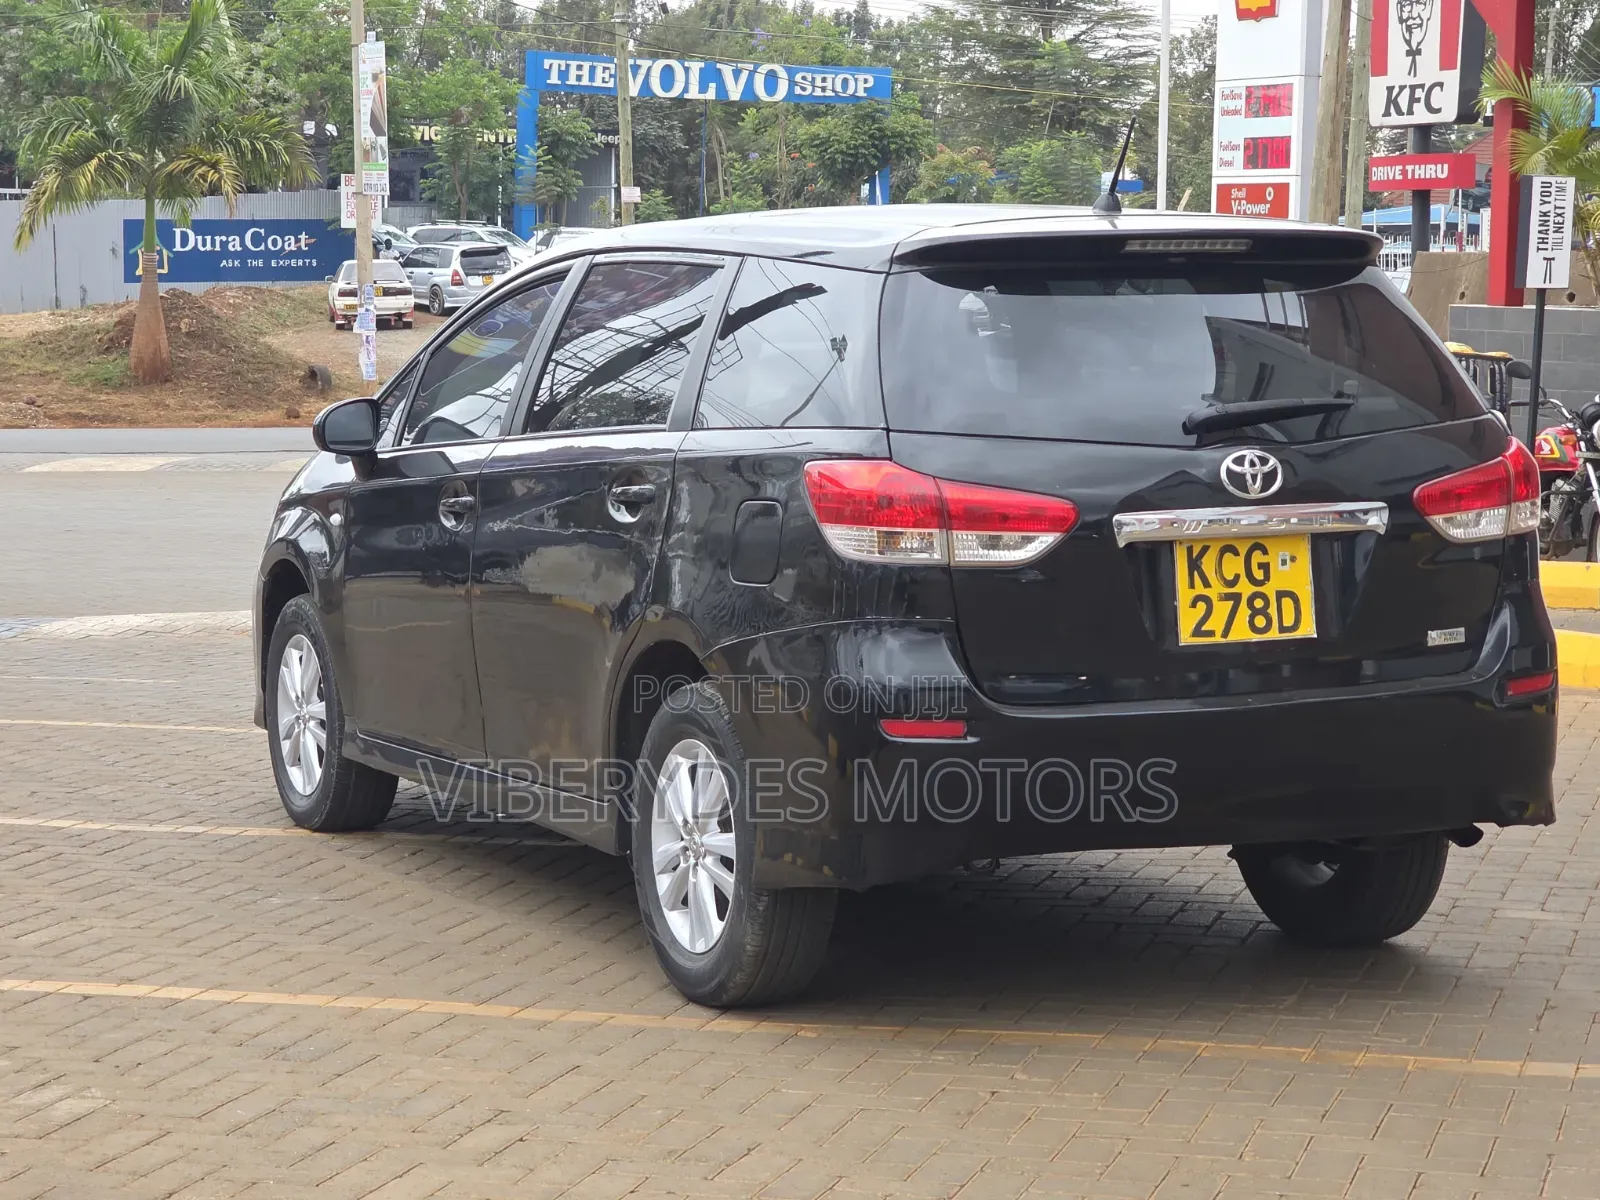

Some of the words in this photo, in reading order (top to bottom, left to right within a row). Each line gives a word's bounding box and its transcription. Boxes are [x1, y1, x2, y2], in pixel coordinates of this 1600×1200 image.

[543, 58, 615, 88] THE
[615, 58, 789, 102] VOLVO
[794, 71, 875, 97] SHOP
[1221, 90, 1242, 101] FuelSave
[1381, 81, 1445, 118] KFC
[1220, 105, 1242, 117] Unleaded
[1219, 141, 1241, 152] FuelSave
[1219, 157, 1235, 168] Diesel
[1371, 165, 1403, 181] DRIVE
[1405, 163, 1449, 180] THRU
[1231, 188, 1246, 199] Shell
[1539, 180, 1553, 209] YOU
[1555, 180, 1567, 204] TIME
[1231, 200, 1271, 215] V-Power
[1552, 204, 1566, 233] NEXT
[1536, 210, 1552, 253] THANK
[1551, 233, 1564, 252] TILL
[220, 259, 241, 267] ASK
[247, 259, 264, 267] THE
[271, 259, 317, 267] EXPERTS
[1186, 541, 1271, 590] KCG
[1188, 589, 1303, 639] 278D
